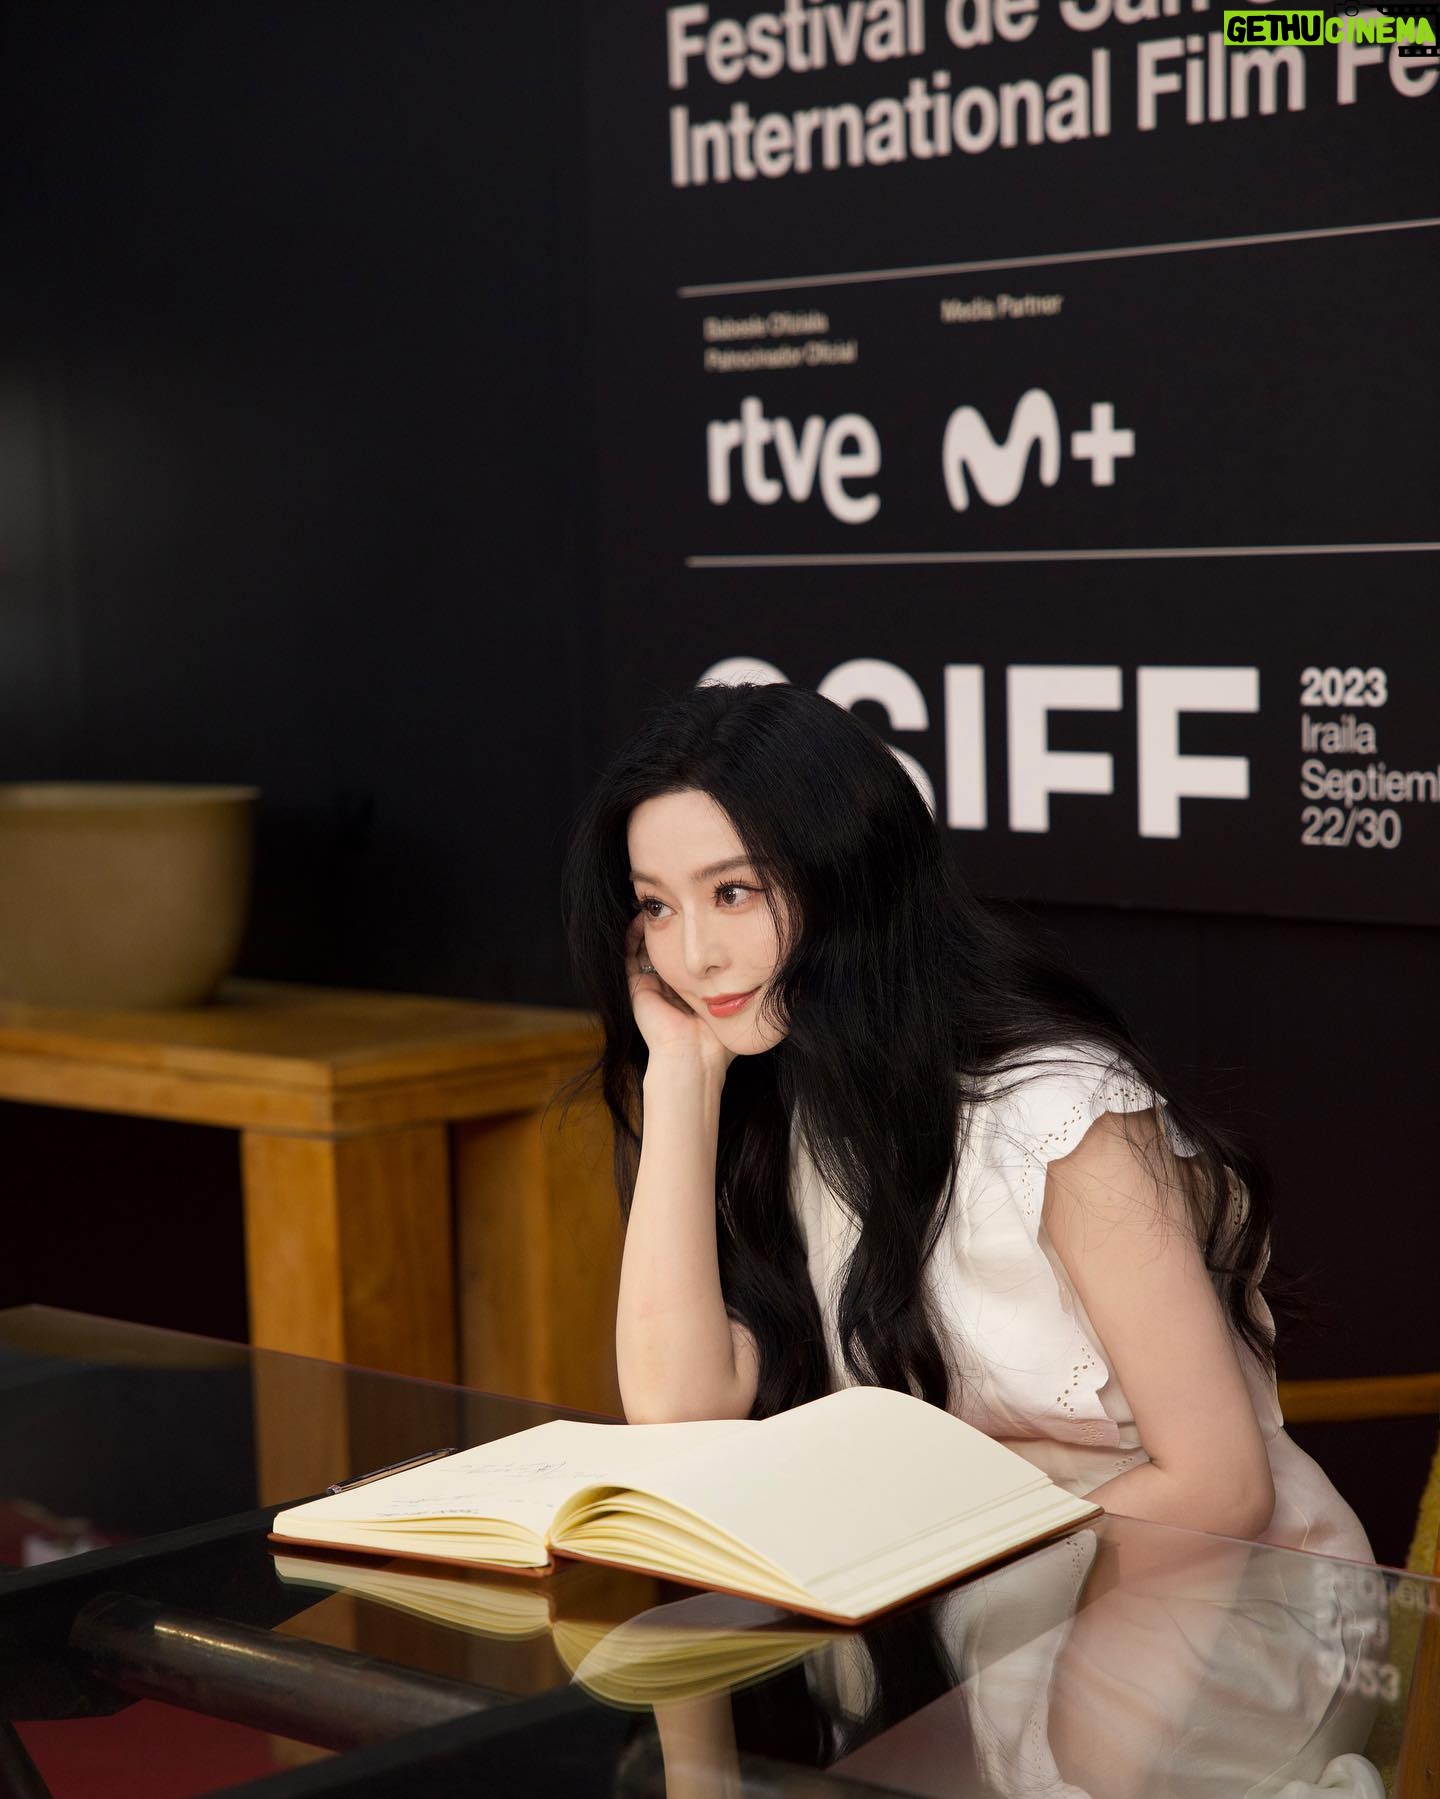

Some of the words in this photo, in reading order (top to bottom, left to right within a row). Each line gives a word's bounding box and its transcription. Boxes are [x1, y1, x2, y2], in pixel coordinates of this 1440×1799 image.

[666, 0, 925, 90] Festival
[669, 48, 1111, 188] International
[1137, 31, 1306, 132] Film
[706, 396, 882, 525] rtve
[1300, 666, 1389, 708] 2023
[696, 656, 1260, 839] SIFF
[1301, 713, 1377, 754] Iraila
[1301, 758, 1440, 809] Septiem
[1301, 805, 1401, 849] 22/30
